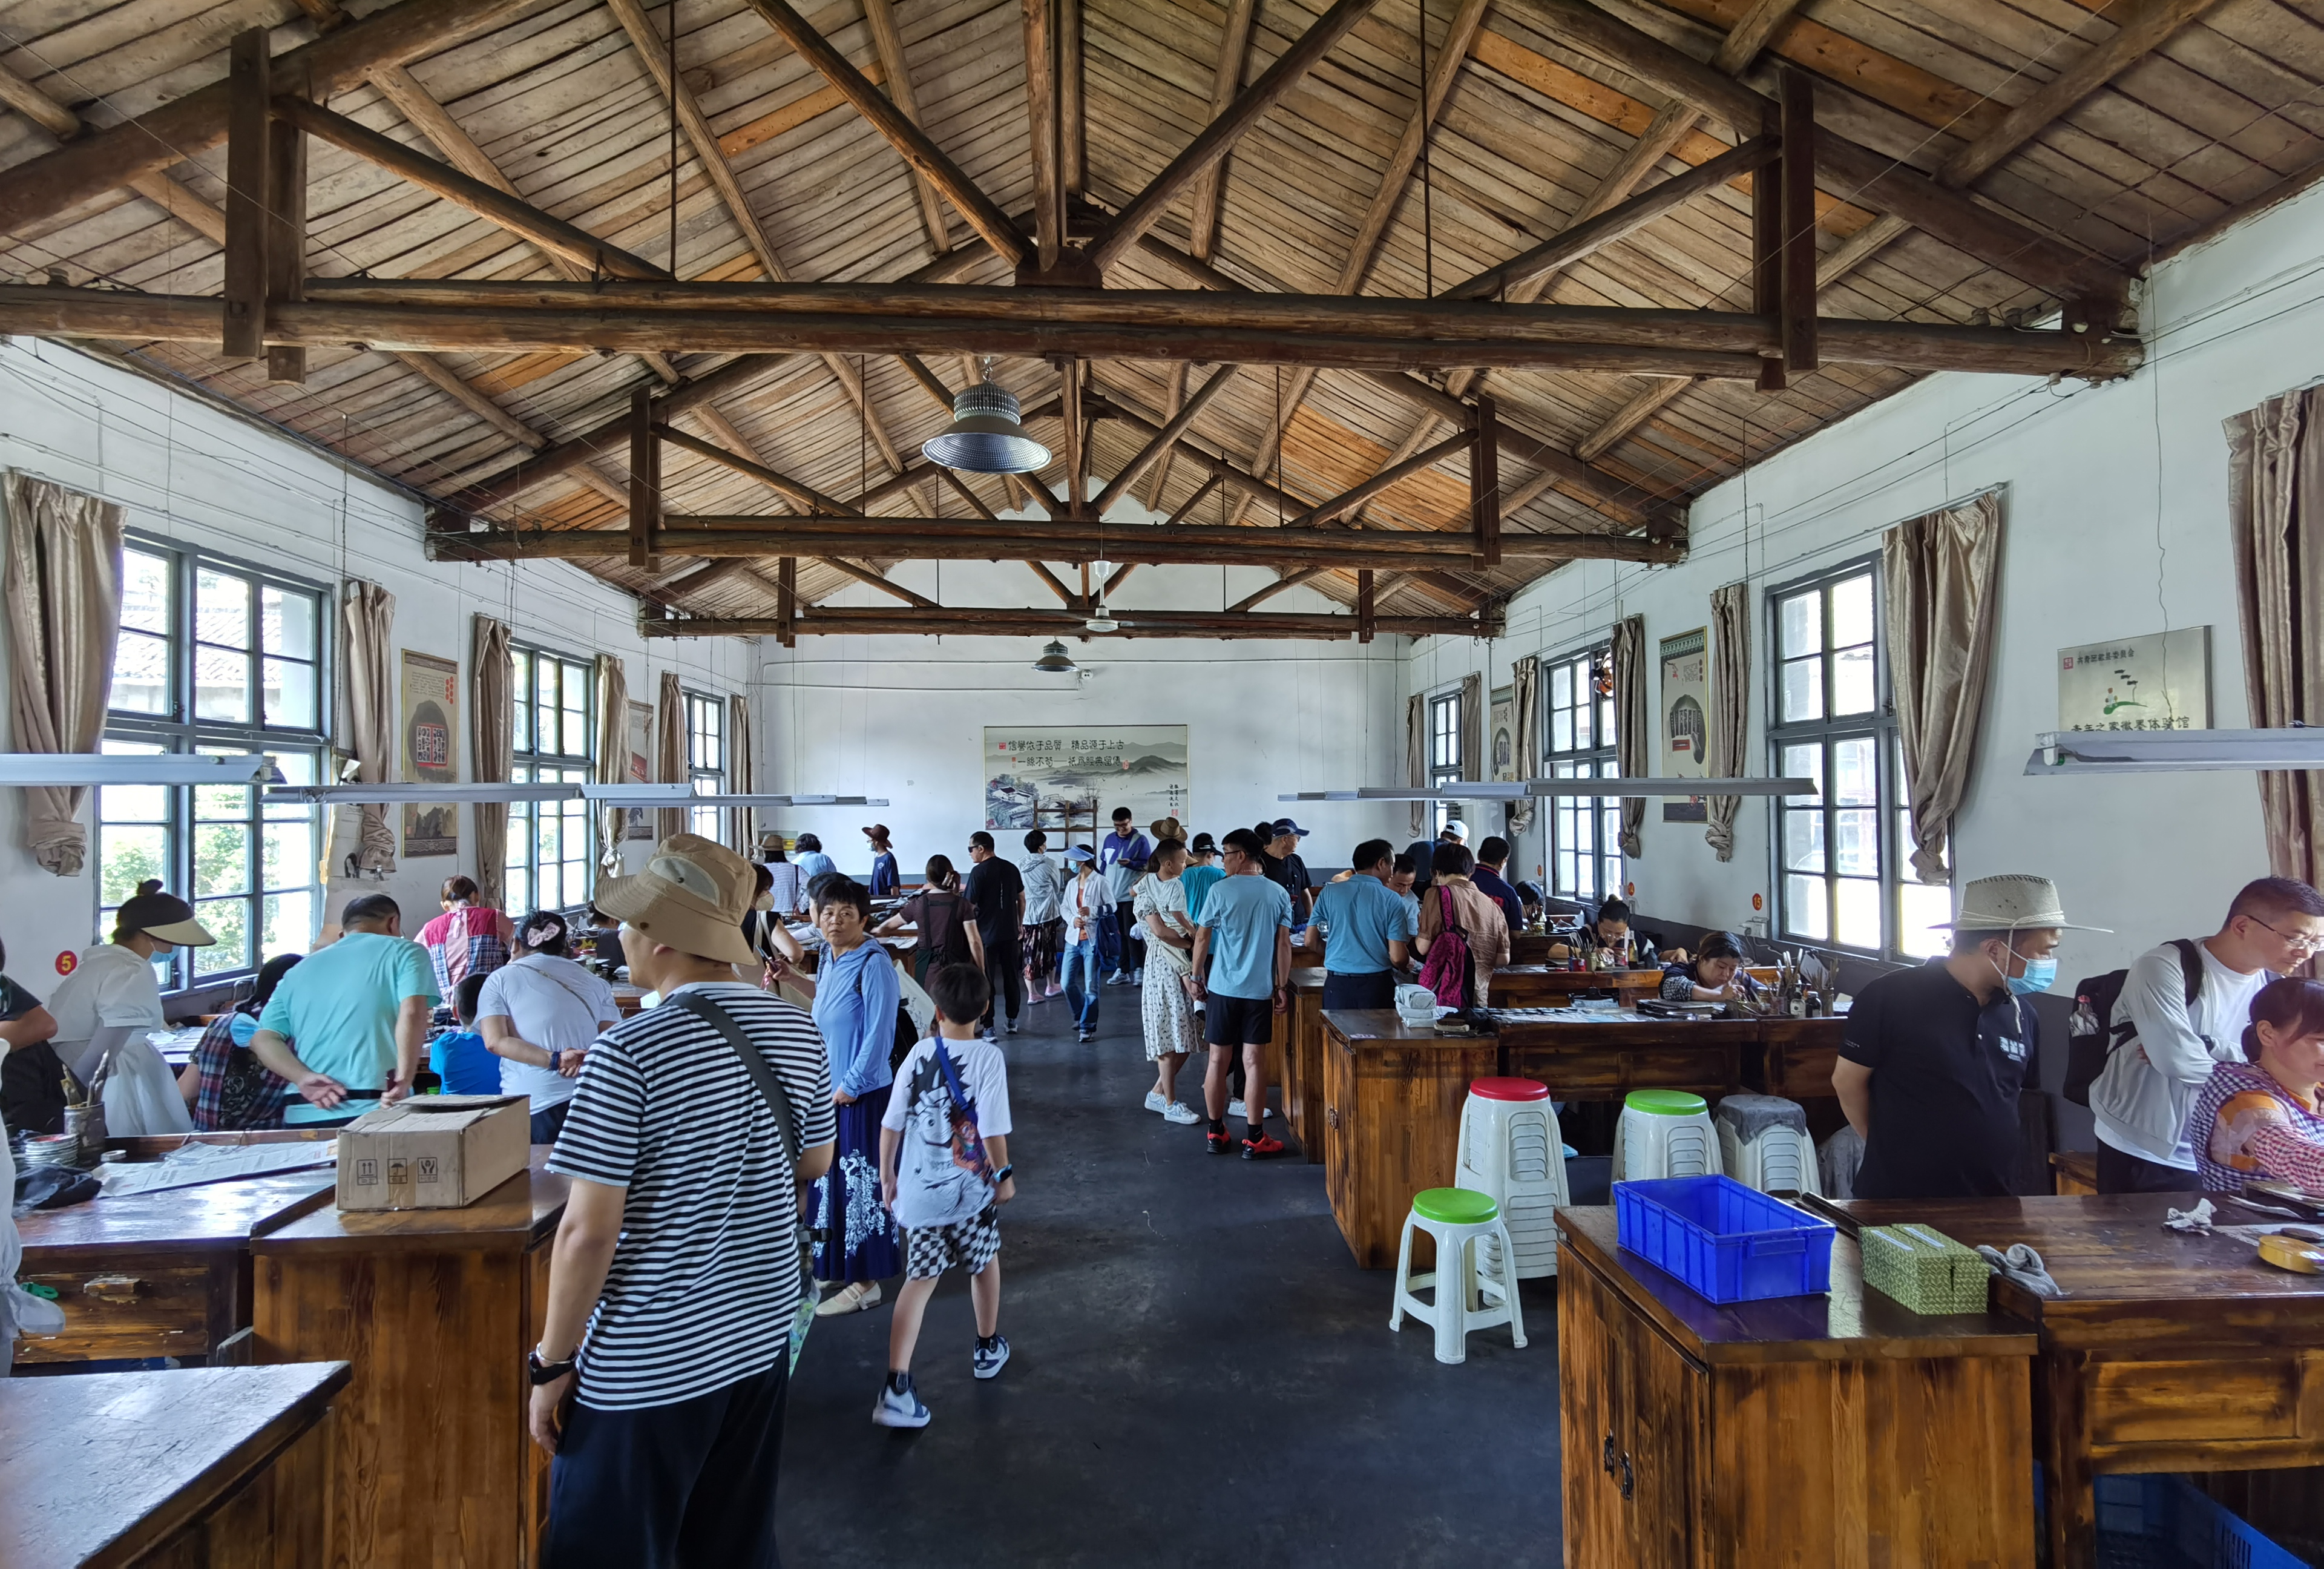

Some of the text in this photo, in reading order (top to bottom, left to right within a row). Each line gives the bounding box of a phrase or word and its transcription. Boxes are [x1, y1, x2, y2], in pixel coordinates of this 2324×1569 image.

[1071, 740, 1124, 751] 精品源于上古
[1754, 896, 1761, 908] 15
[62, 955, 71, 971] 5
